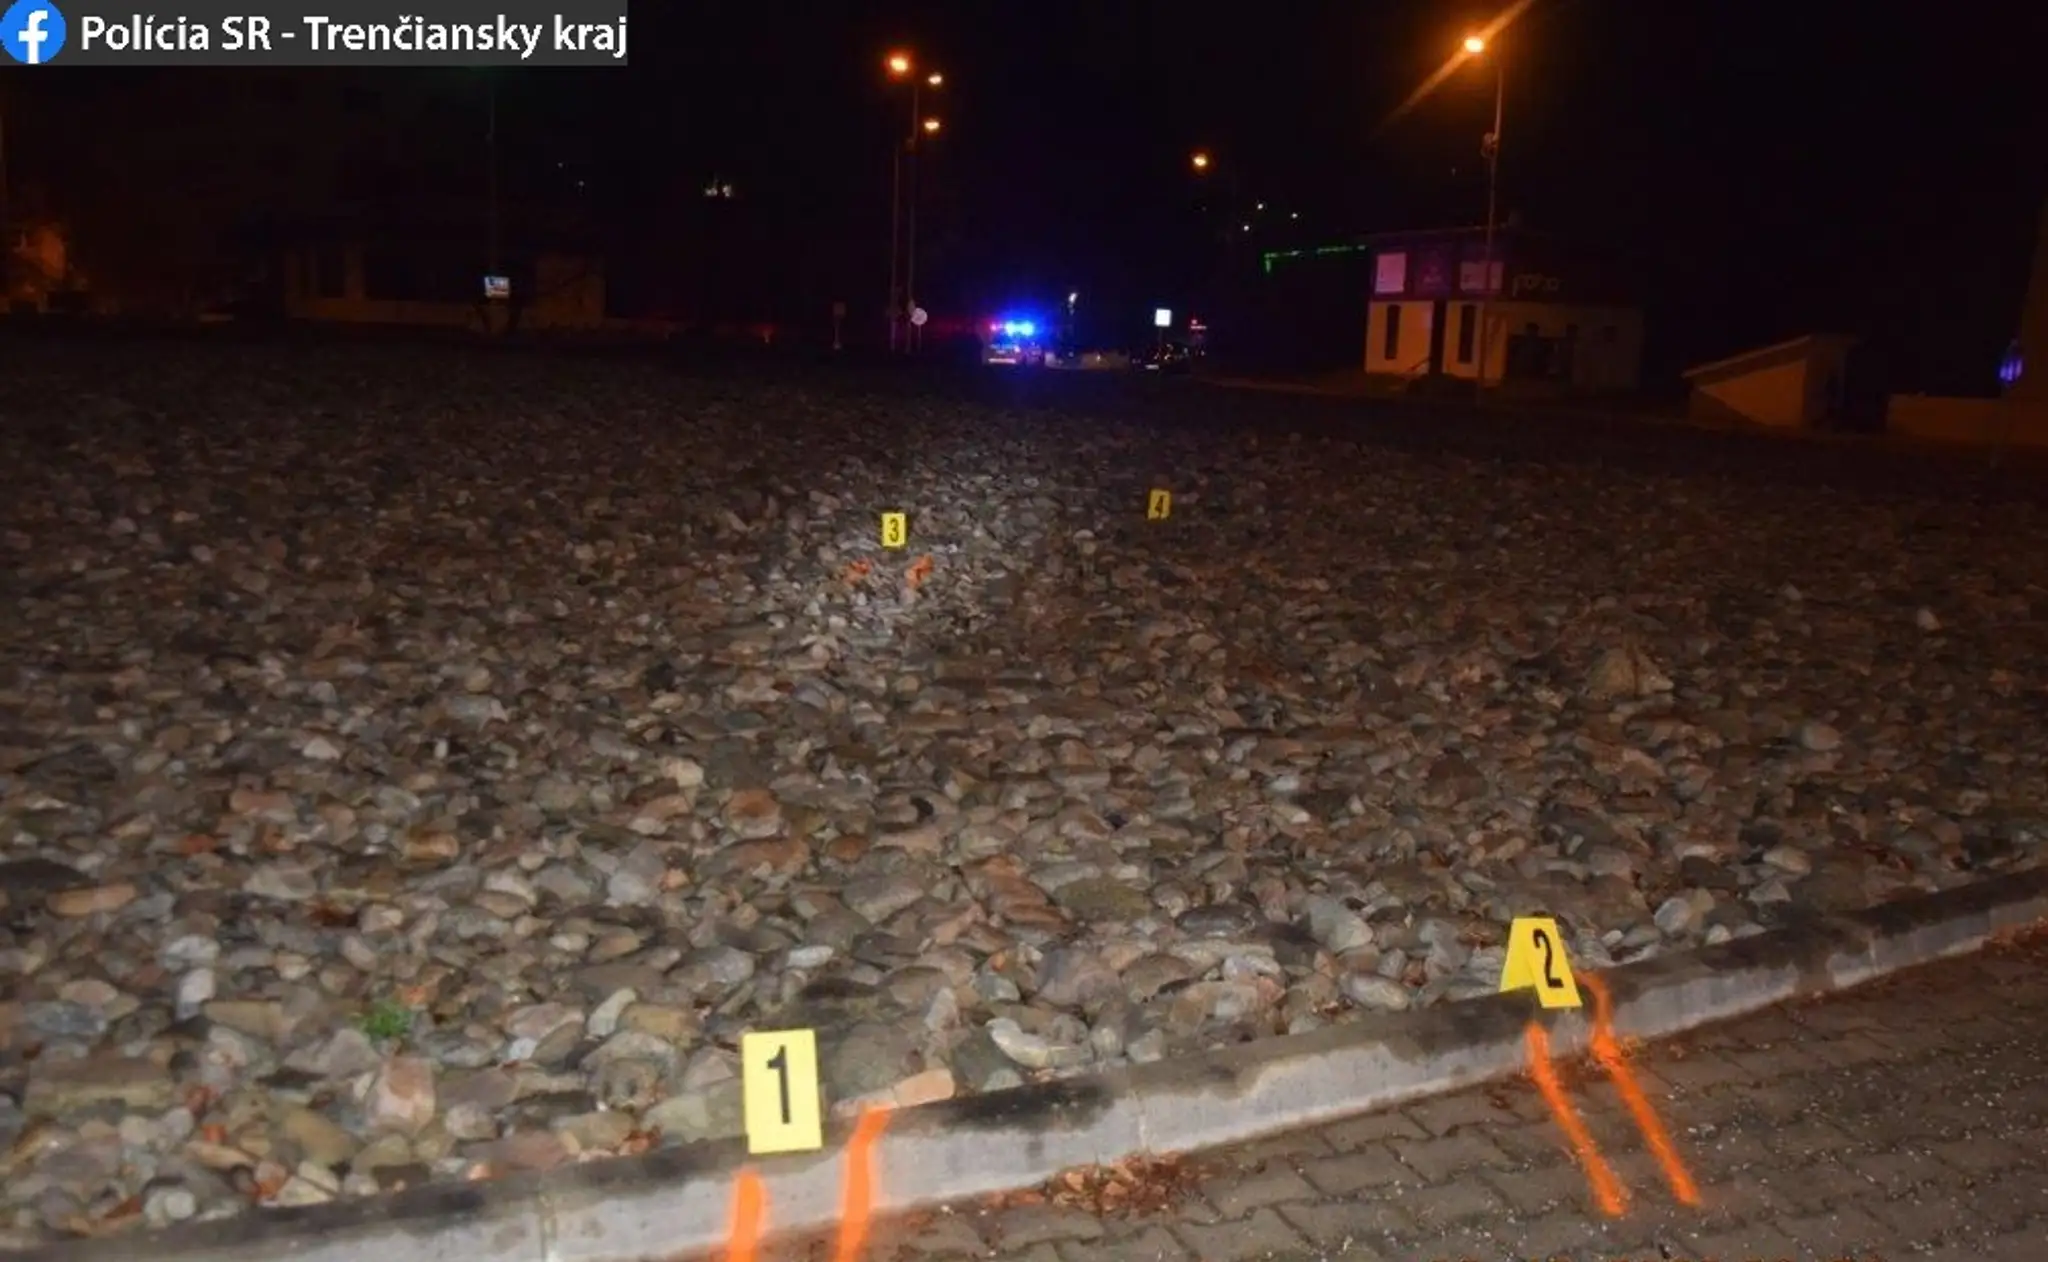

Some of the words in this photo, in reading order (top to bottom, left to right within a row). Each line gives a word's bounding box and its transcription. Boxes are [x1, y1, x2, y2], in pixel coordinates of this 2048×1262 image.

[889, 517, 899, 542] 3
[1533, 928, 1565, 989] 2
[766, 1044, 791, 1125] 1
